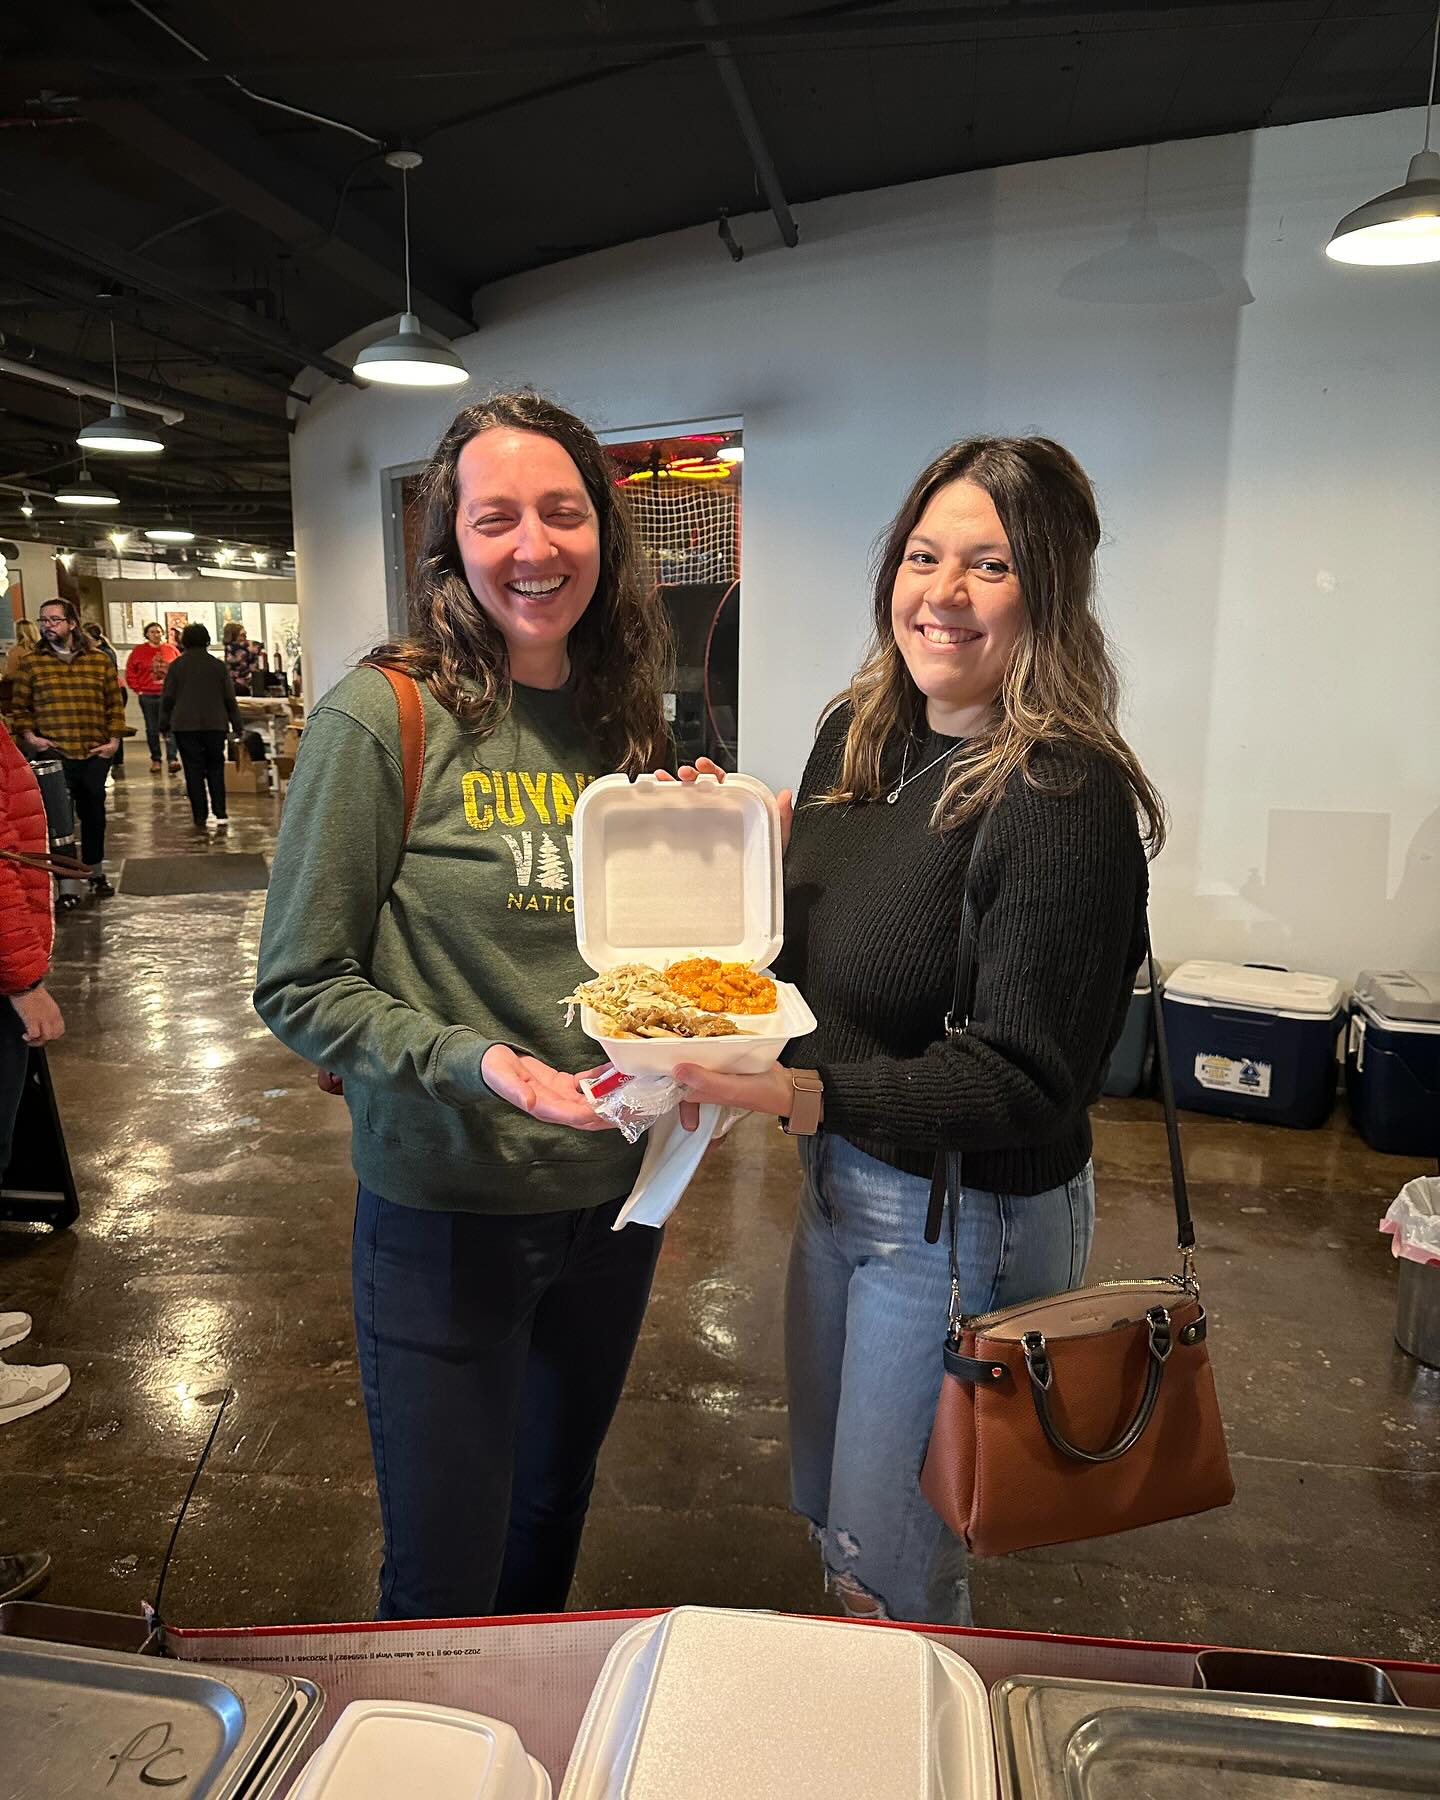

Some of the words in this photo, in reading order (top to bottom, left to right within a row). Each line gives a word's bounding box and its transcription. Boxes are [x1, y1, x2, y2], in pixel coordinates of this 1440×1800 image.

[461, 770, 595, 831] CUYA
[506, 893, 575, 913] NATIO
[375, 1651, 393, 1659] Vinyl
[442, 1648, 481, 1657] 2022-09-06
